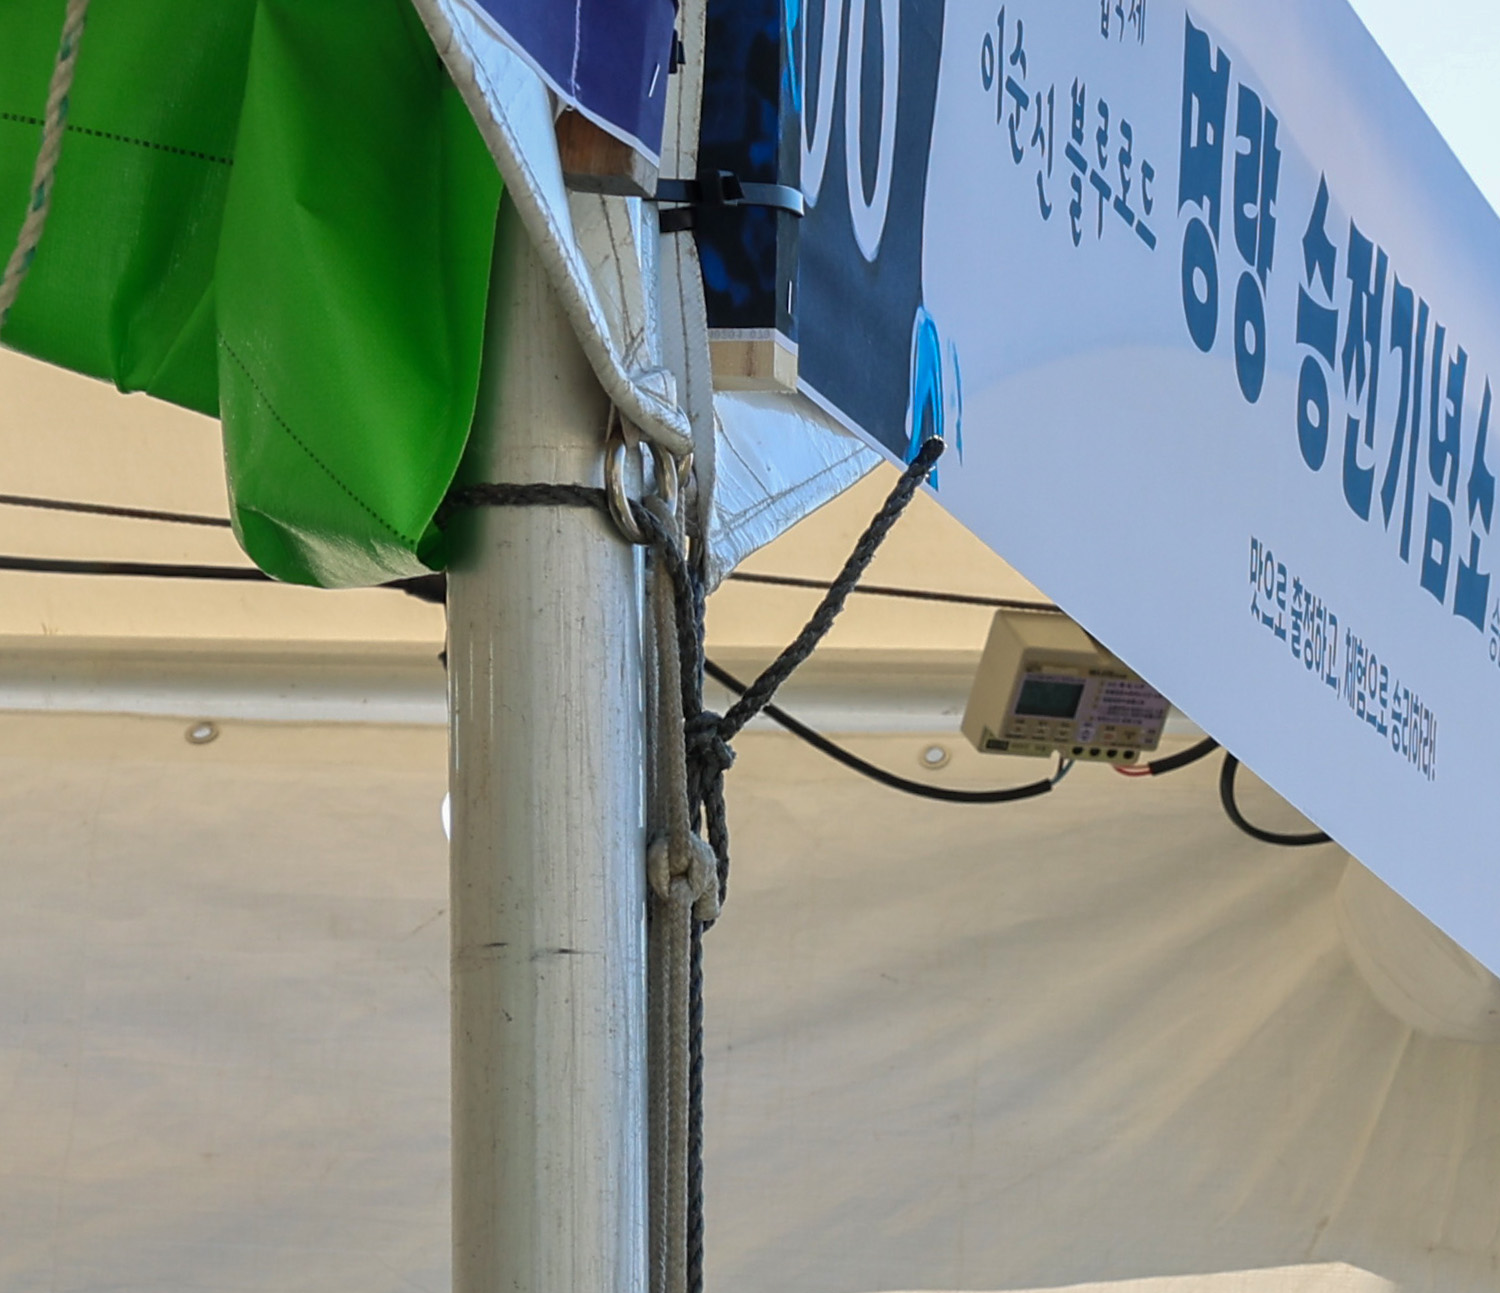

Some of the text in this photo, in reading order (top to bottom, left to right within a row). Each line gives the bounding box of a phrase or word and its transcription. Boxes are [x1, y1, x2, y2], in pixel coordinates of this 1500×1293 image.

[981, 7, 1055, 222] 이순신
[1065, 76, 1157, 252] 블루로드
[1178, 9, 1497, 634] 명량 승전기념소
[1249, 535, 1438, 782] 맛으로 출정하고, 체험으로 승리하라!
